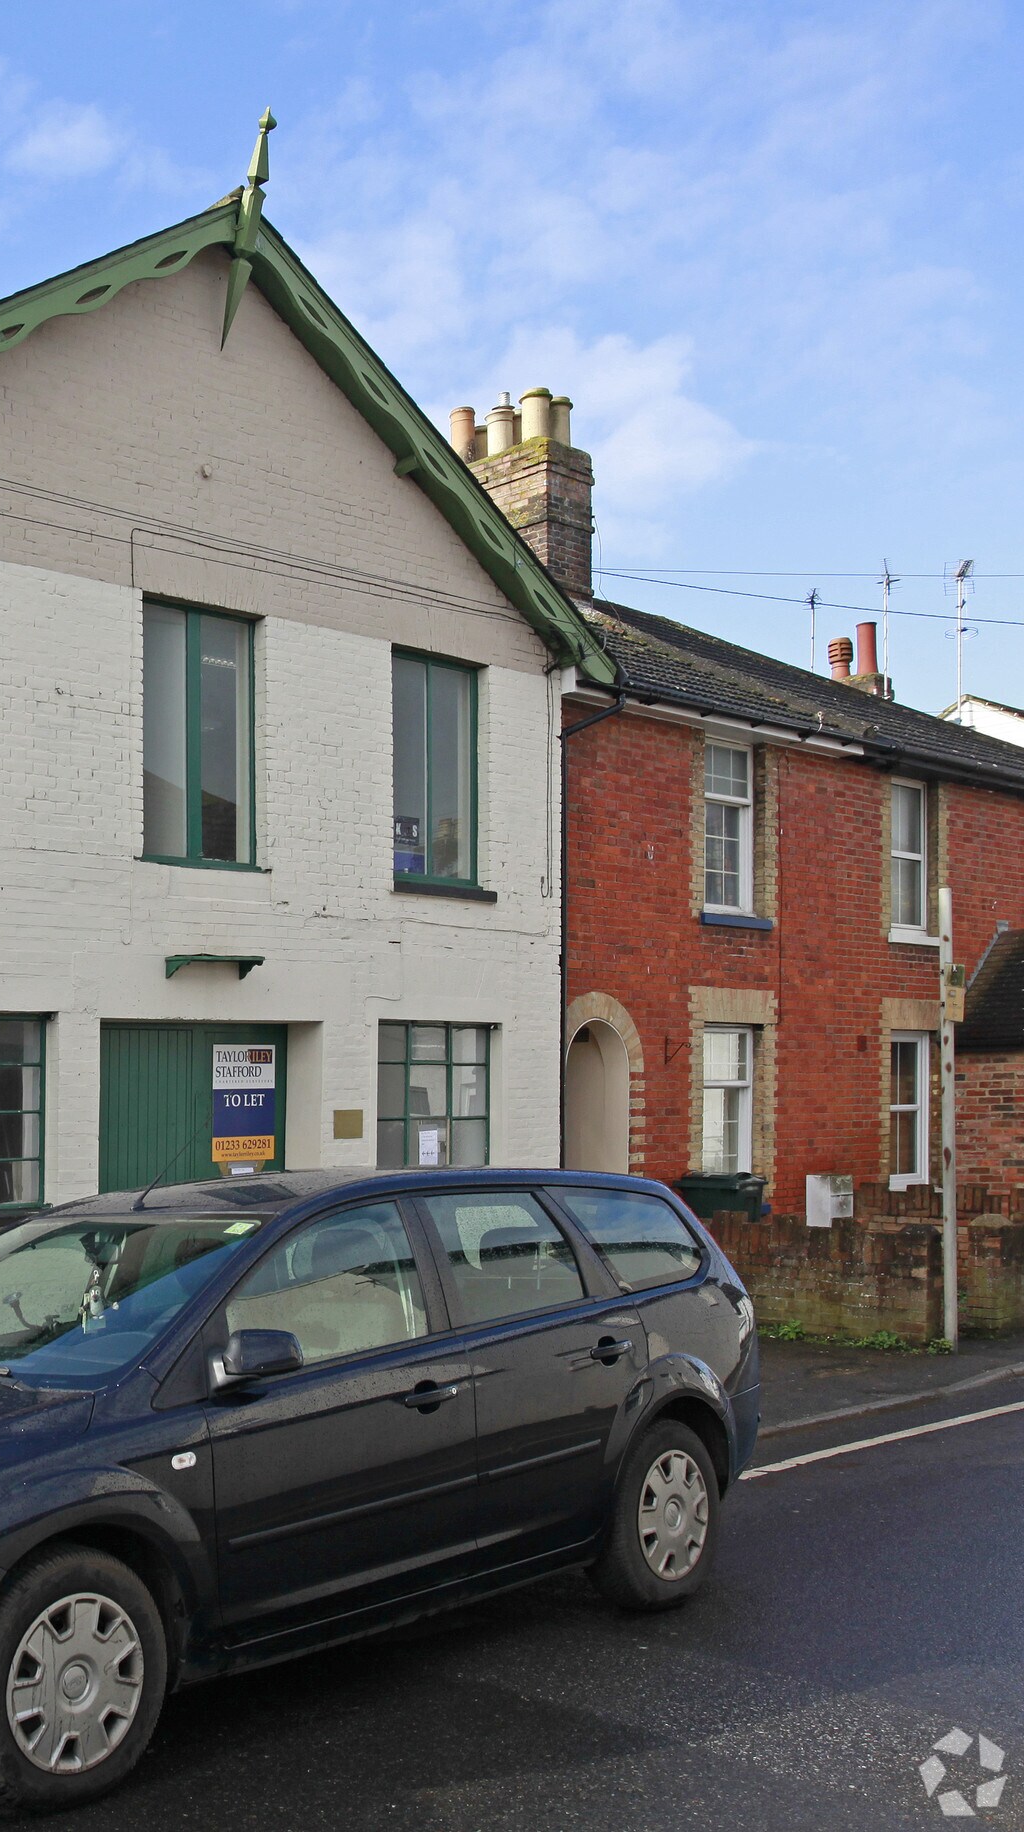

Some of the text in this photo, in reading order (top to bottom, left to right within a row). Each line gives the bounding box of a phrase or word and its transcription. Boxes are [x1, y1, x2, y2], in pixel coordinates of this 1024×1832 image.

[215, 1066, 262, 1078] STAFFORD
[223, 1093, 266, 1107] TO LET
[215, 1139, 271, 1151] 01233 629281
